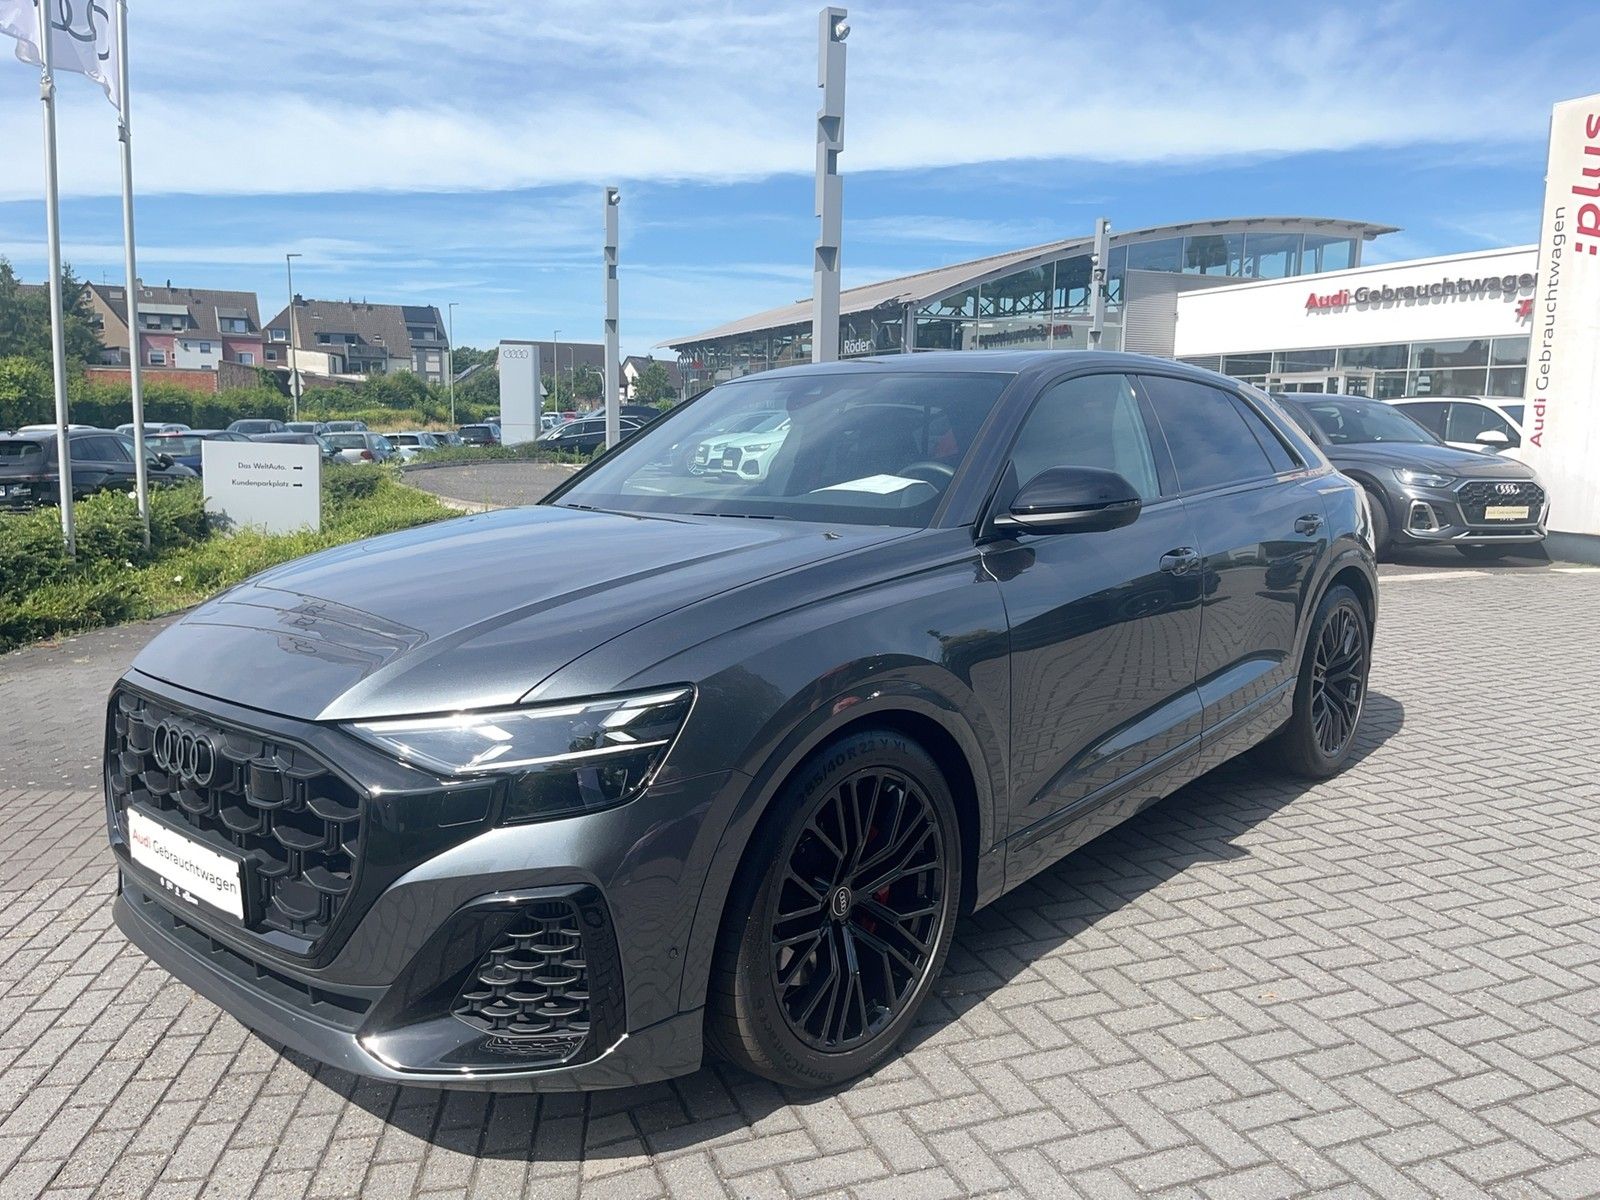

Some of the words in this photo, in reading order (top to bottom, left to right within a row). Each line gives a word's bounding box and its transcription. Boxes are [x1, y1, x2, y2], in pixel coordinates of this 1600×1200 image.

[1305, 288, 1350, 309] Audi
[1535, 205, 1567, 392] Gebrauchtwagen
[844, 338, 871, 354] Röder
[1529, 397, 1548, 449] Audi
[253, 462, 287, 470] WeltAuto.
[231, 479, 289, 488] Kundenparkplatz
[132, 829, 151, 849] Audi
[153, 840, 237, 895] Gebrauchtwagen
